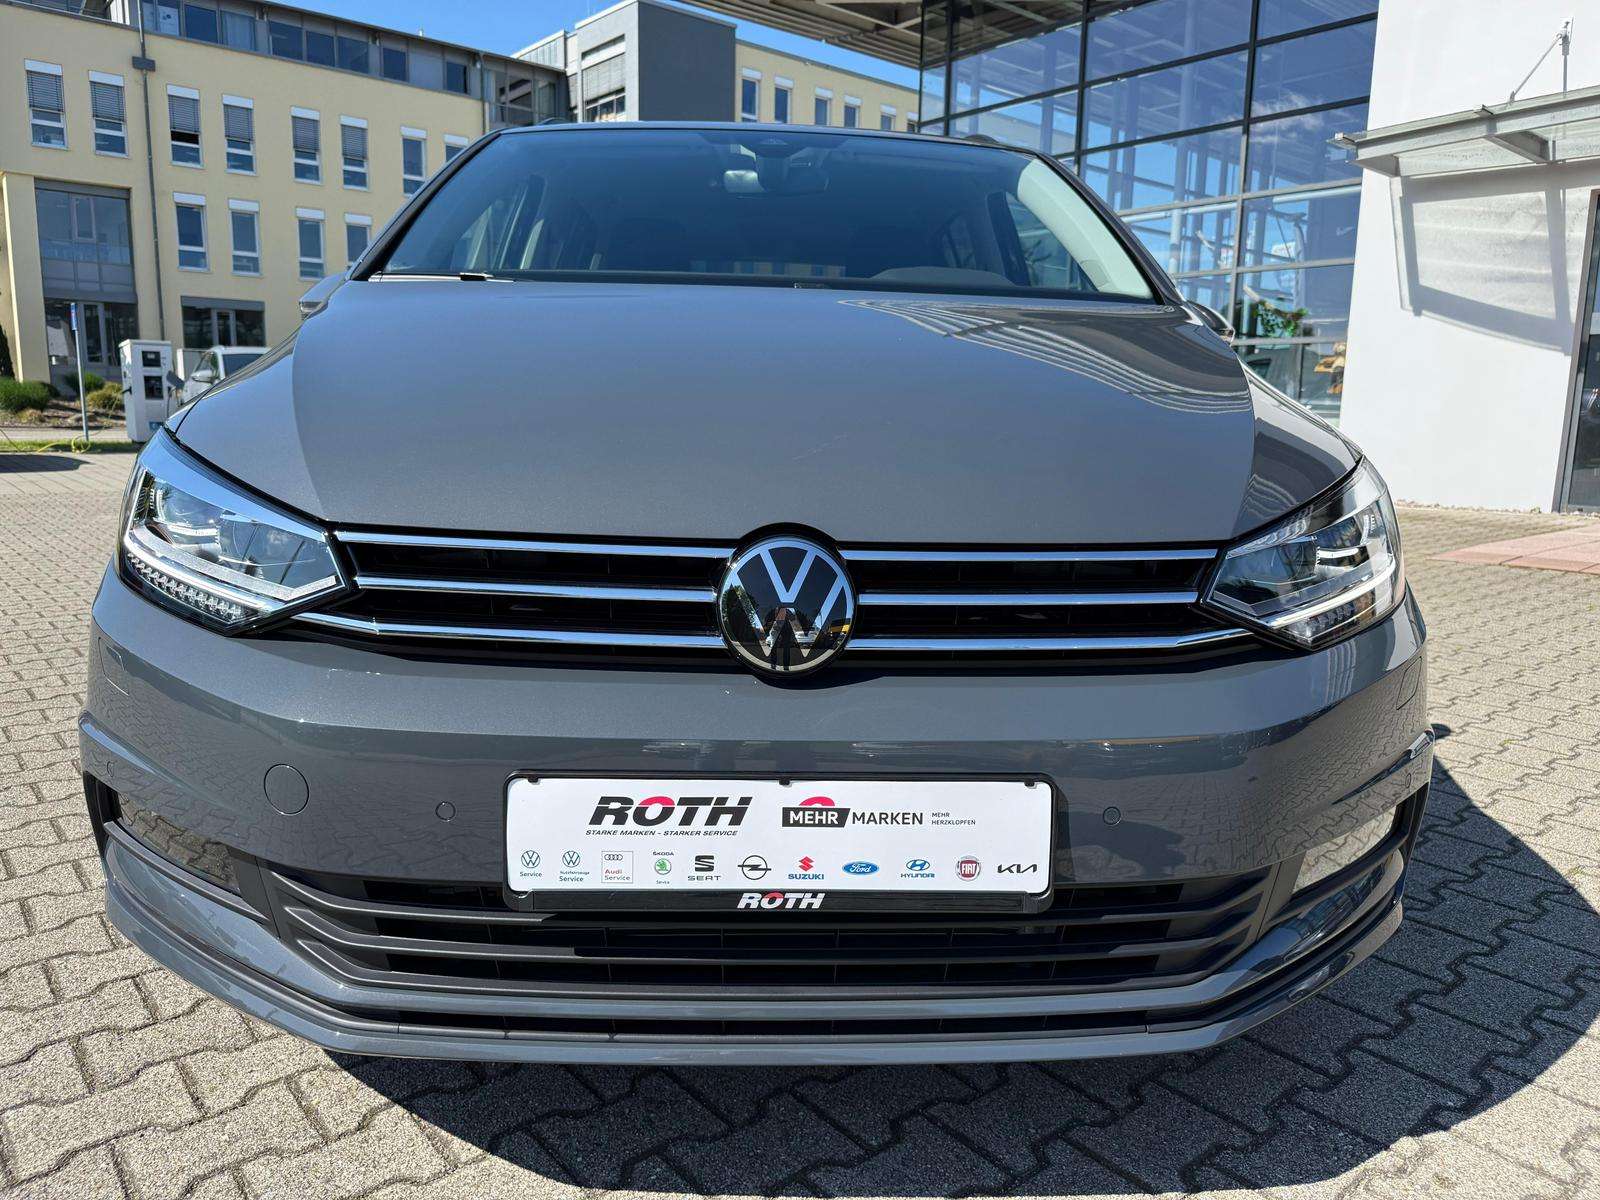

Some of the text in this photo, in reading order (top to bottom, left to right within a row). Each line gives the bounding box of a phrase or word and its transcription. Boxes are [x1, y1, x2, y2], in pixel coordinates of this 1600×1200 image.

[588, 796, 753, 827] ROTH
[789, 811, 923, 825] MEHR MARKEN
[849, 862, 872, 873] Ford
[961, 863, 977, 875] FIAT
[737, 890, 826, 909] ROTH
